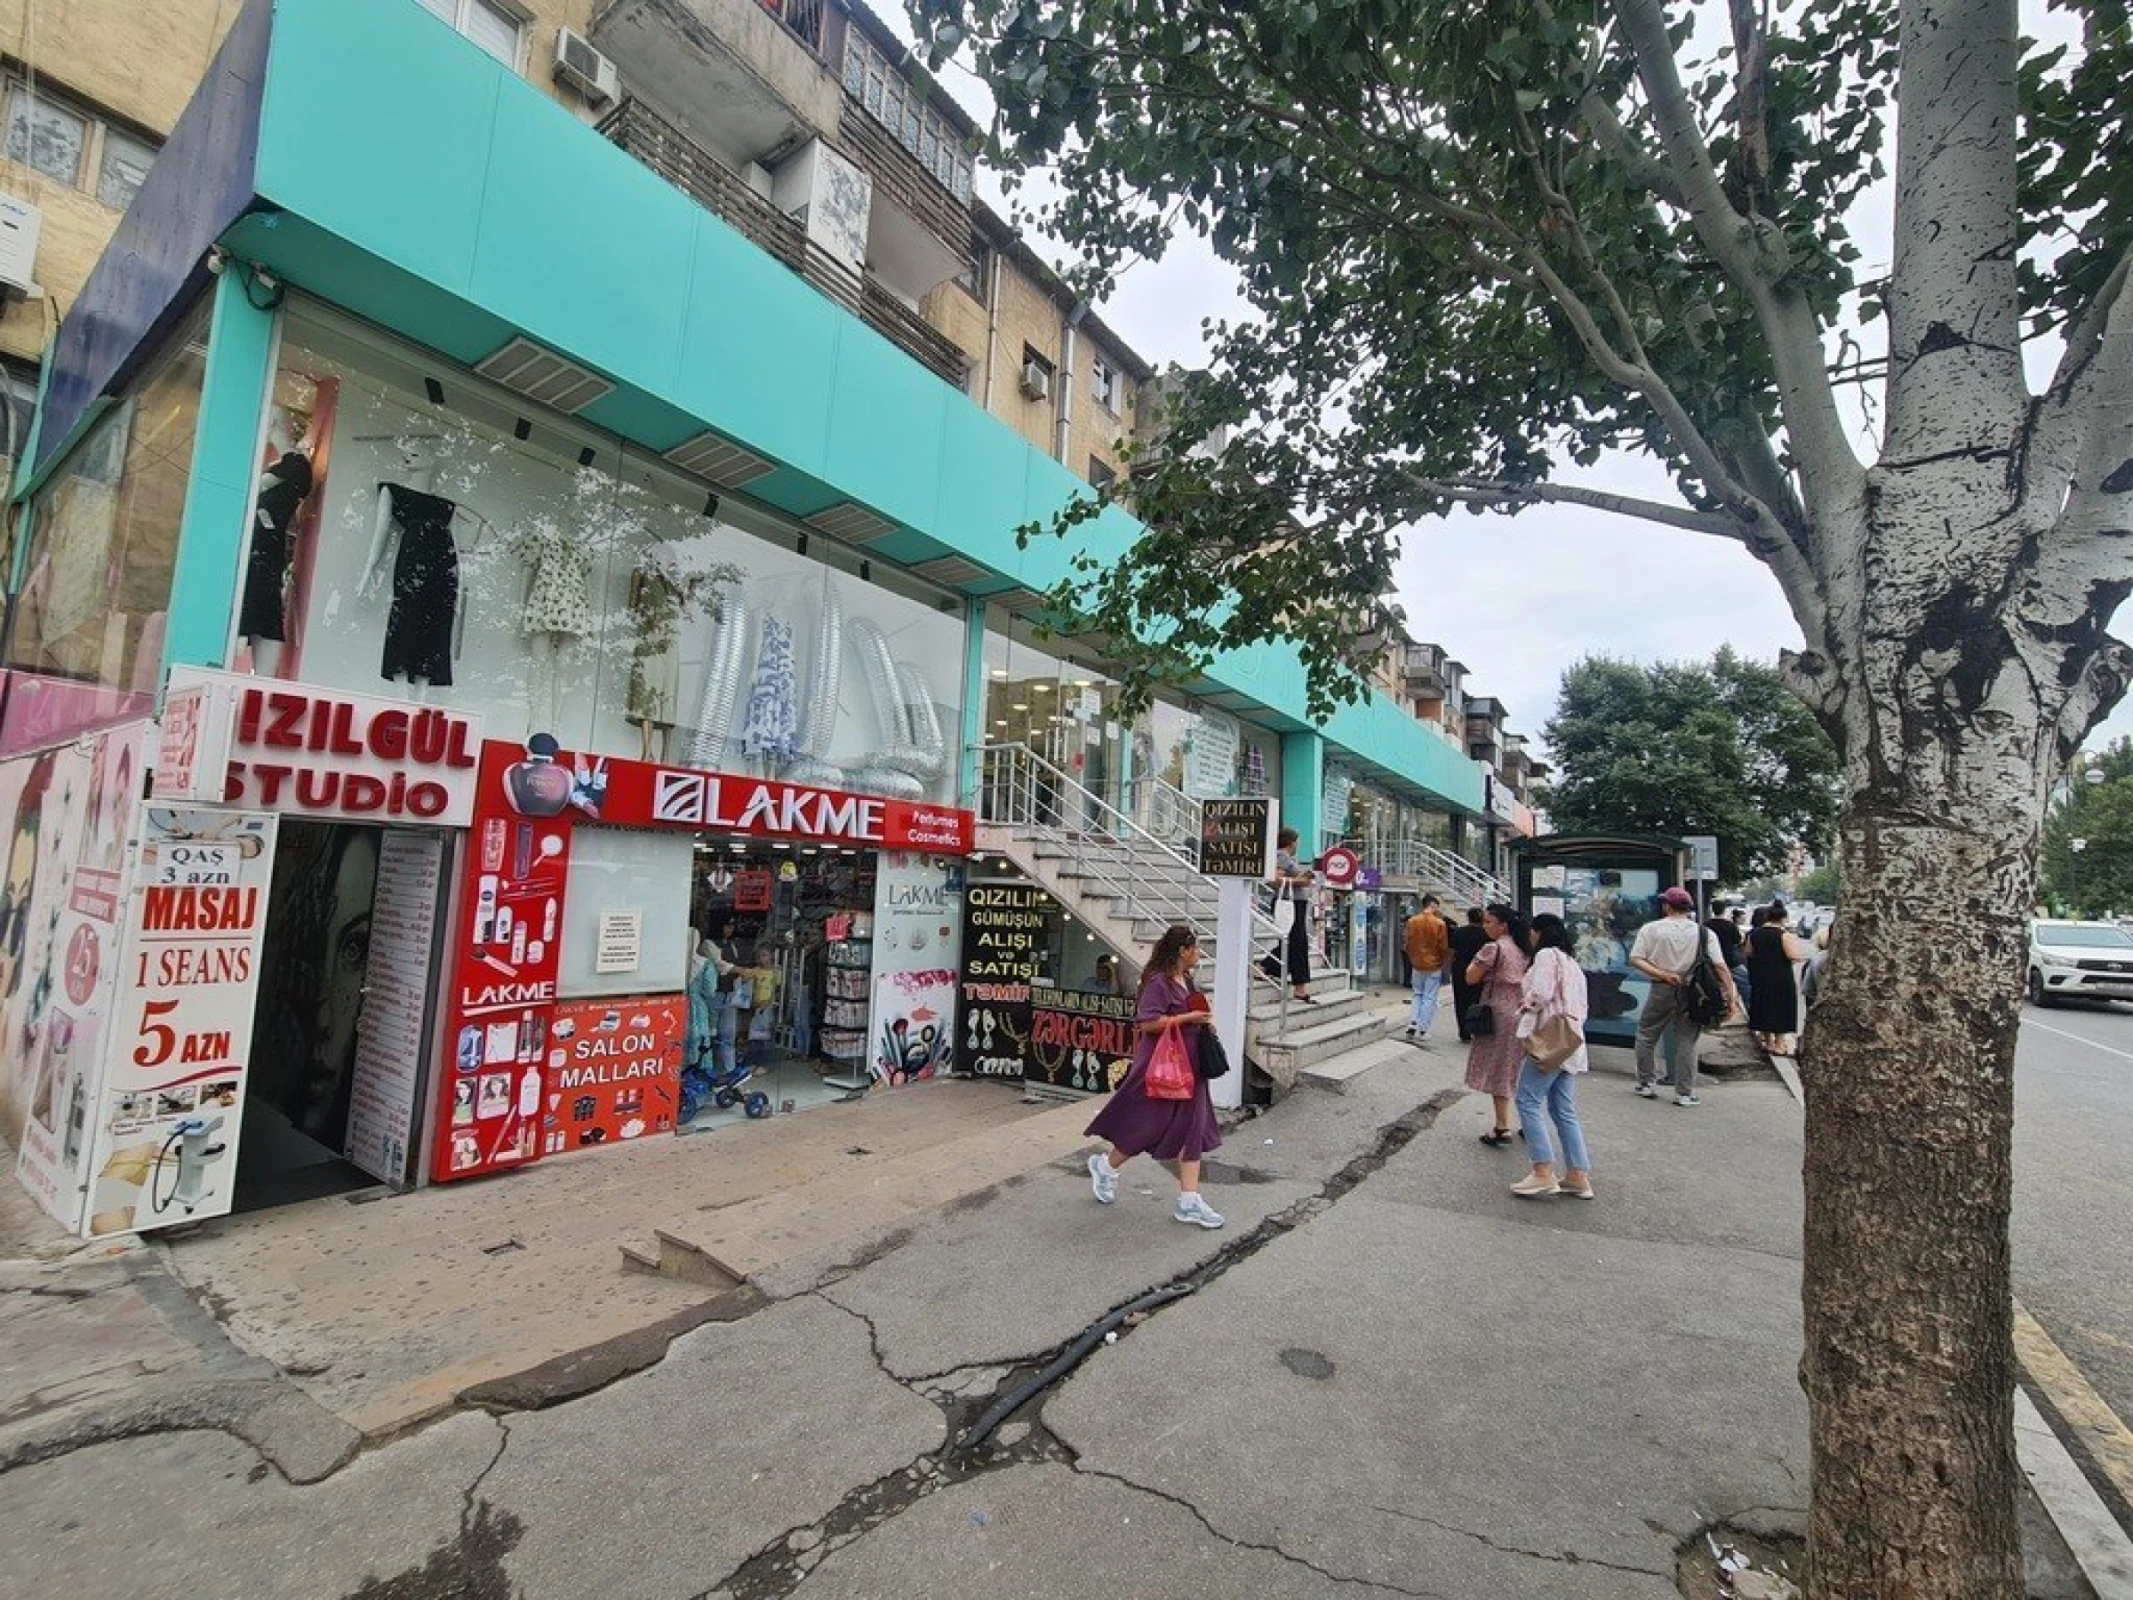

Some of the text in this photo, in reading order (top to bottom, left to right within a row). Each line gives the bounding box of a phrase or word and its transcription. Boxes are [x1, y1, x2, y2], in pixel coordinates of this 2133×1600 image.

[705, 778, 885, 840] LAKME
[908, 828, 961, 846] Cosmetics
[171, 847, 224, 866] QAŞ
[162, 866, 230, 884] 3 azn
[142, 886, 257, 930] MASAJ
[977, 932, 1032, 950] ALIŞI
[135, 947, 250, 988] 1 SEANS
[968, 960, 1039, 979] SATIŞI
[462, 981, 554, 1005] LAKME
[133, 1000, 232, 1067] 5 AZN
[575, 1034, 655, 1059] SALON
[560, 1058, 663, 1088] MALLARI
